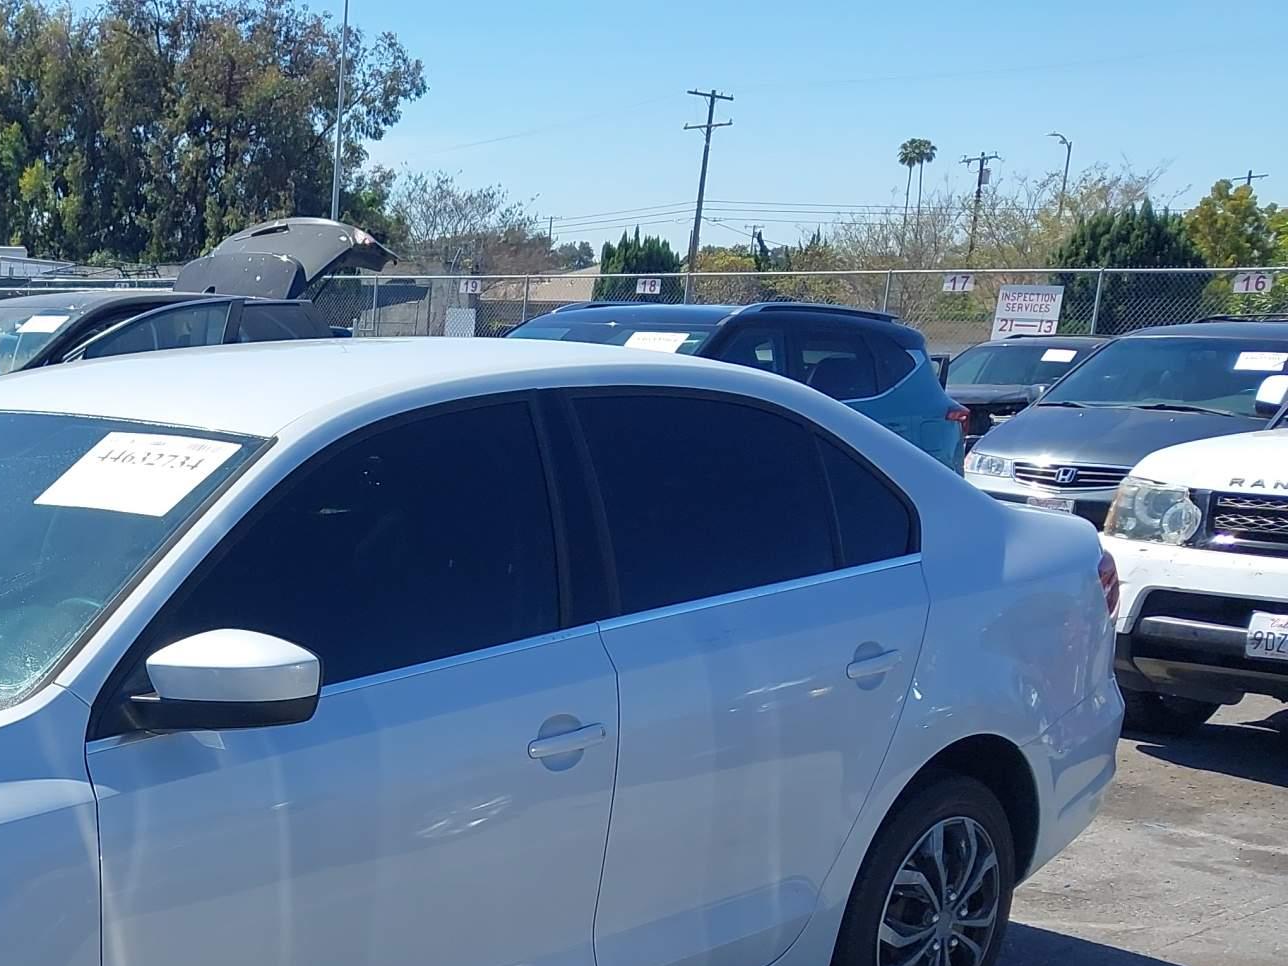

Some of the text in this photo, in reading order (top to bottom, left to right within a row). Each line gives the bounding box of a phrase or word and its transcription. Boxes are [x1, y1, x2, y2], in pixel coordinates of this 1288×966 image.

[464, 280, 478, 293] 19
[641, 279, 657, 293] 18
[950, 275, 970, 290] 17
[1242, 275, 1266, 291] 16
[1001, 292, 1057, 303] INSPECTION
[1005, 302, 1051, 313] SERVICES
